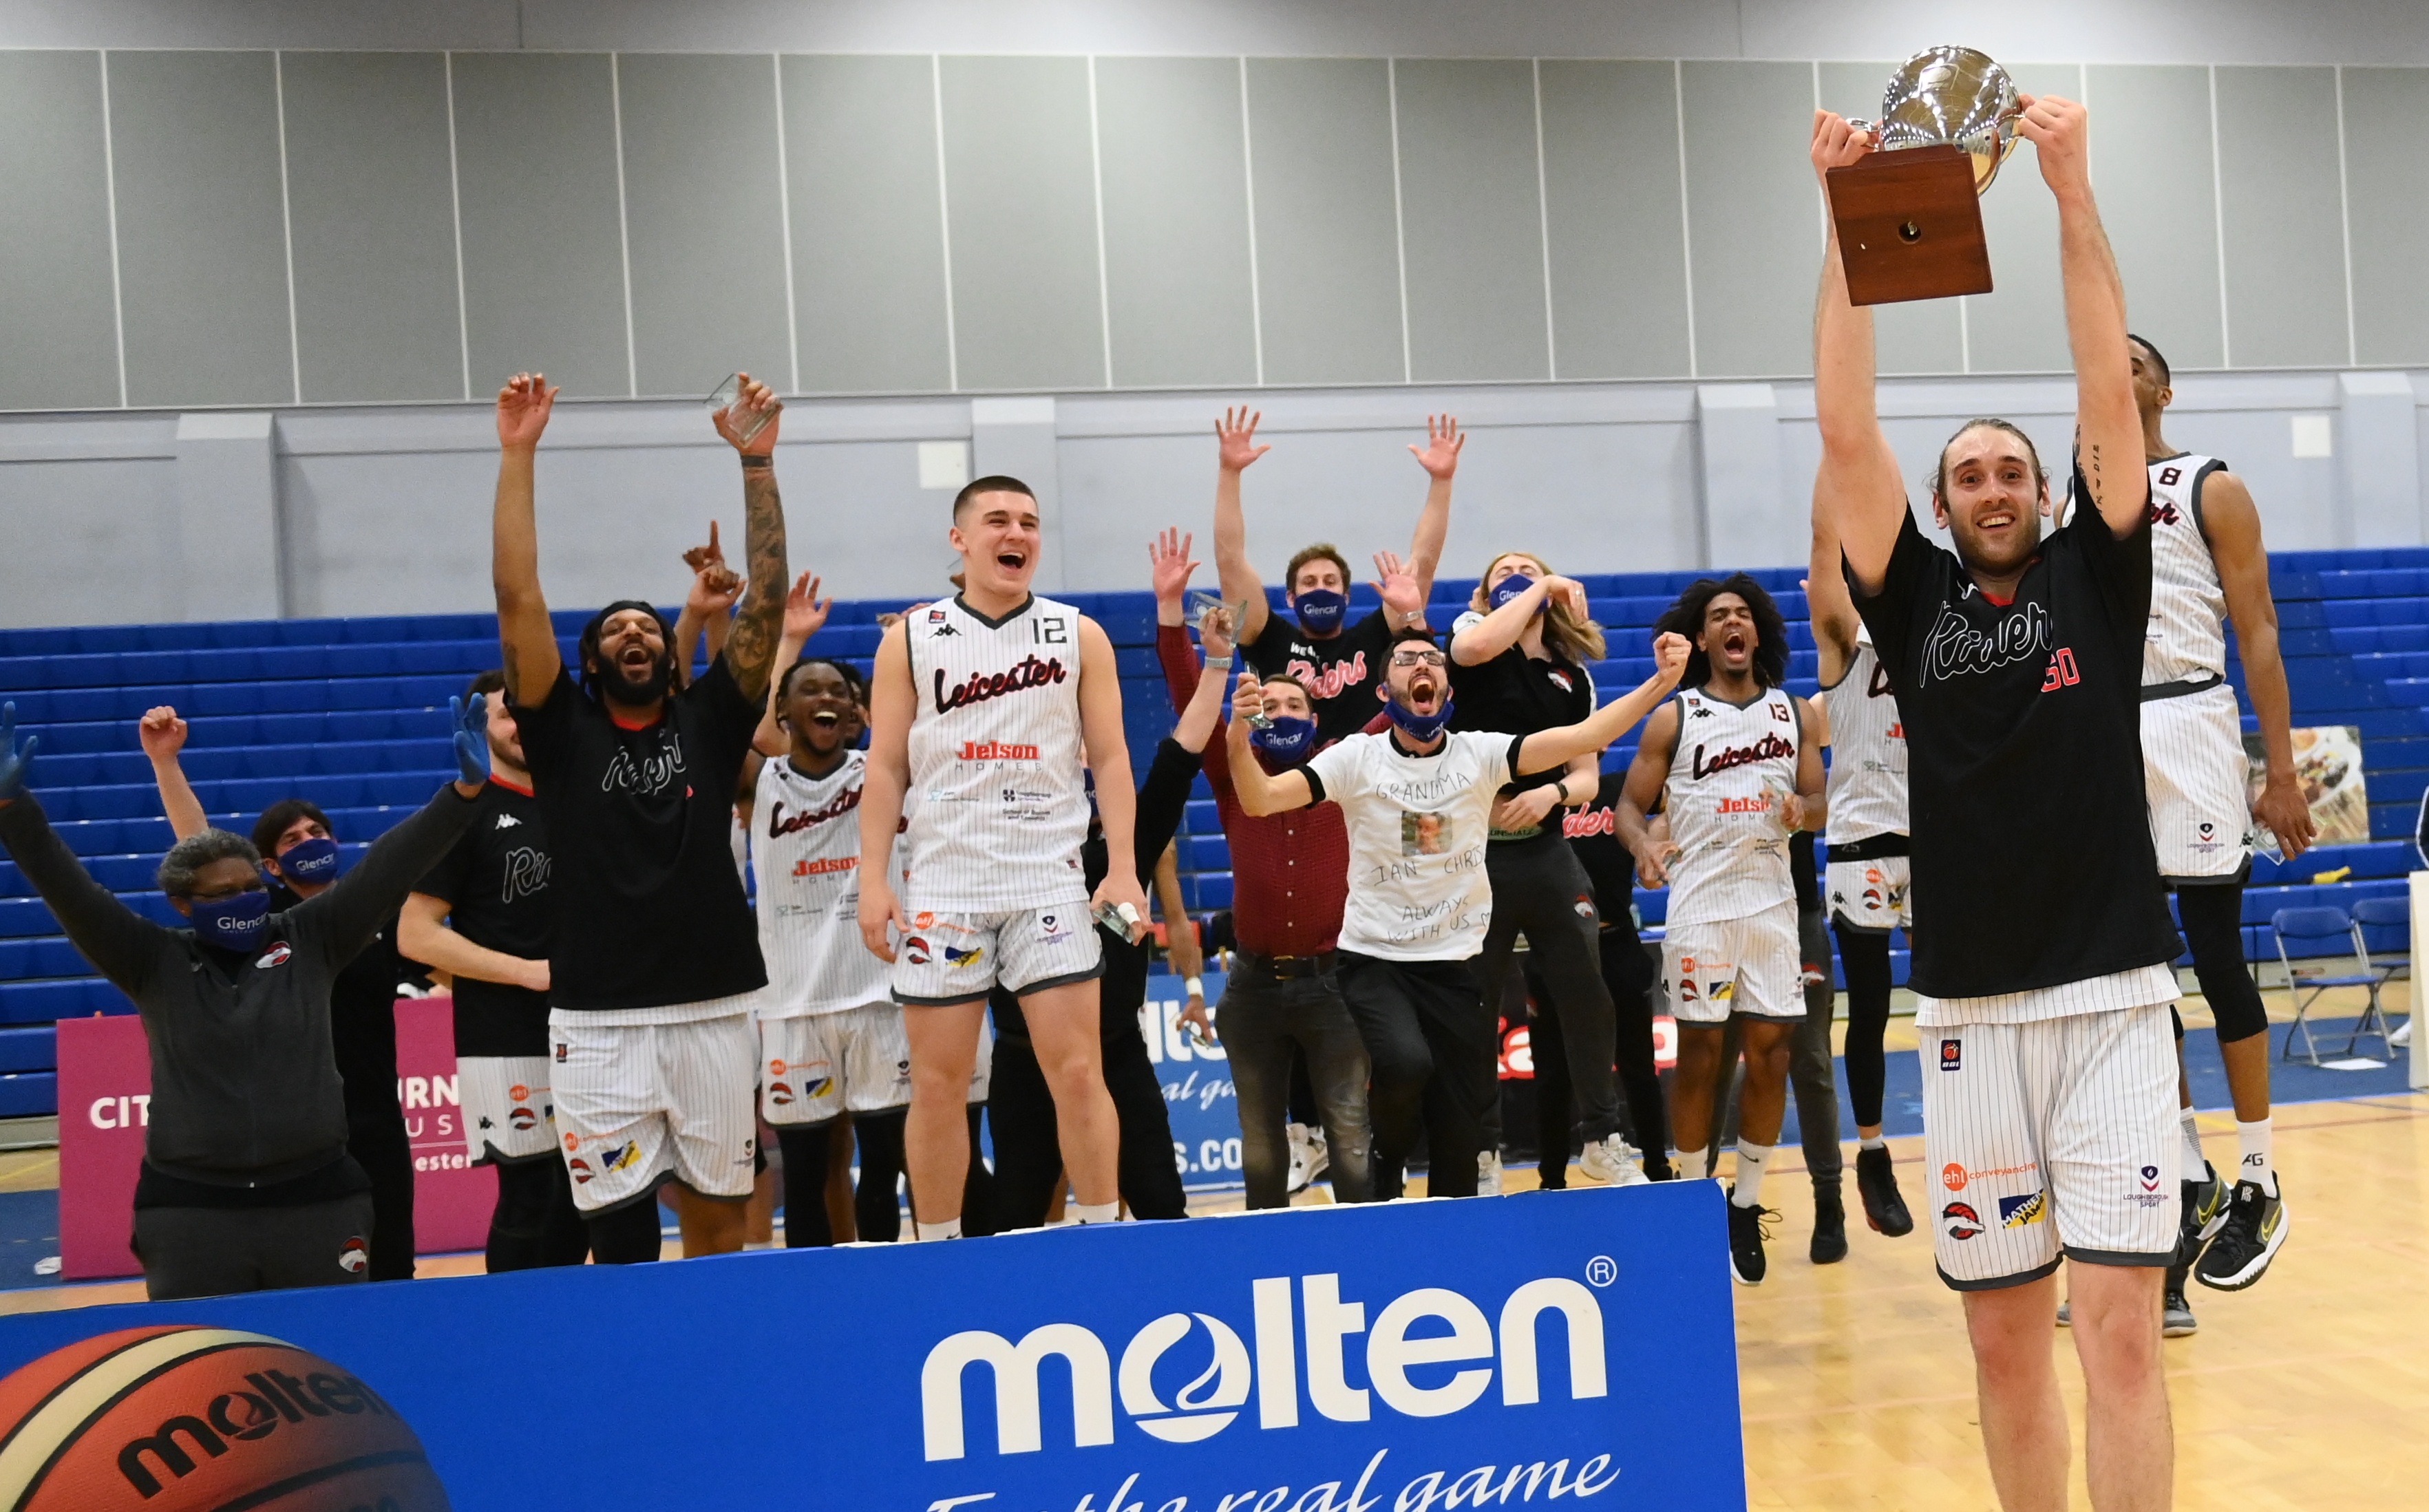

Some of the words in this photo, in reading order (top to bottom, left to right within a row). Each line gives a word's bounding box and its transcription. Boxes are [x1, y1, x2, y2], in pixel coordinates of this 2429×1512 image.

[2158, 467, 2182, 486] 8
[1304, 604, 1338, 615] Glencar
[1033, 617, 1068, 644] 12
[935, 654, 1067, 715] Leicester
[1769, 703, 1790, 723] 13
[958, 741, 1040, 760] Jelson
[1266, 732, 1303, 746] Glencar
[1693, 732, 1795, 780] Leicester
[1377, 772, 1471, 802] GRANDMA
[296, 853, 335, 871] Glencar
[1371, 861, 1417, 886] IAN
[1402, 895, 1468, 922] ALWAYS
[1388, 924, 1441, 942] WITH
[1450, 914, 1470, 930] US
[1943, 1169, 1966, 1184] ehl
[922, 1273, 1607, 1462] molten
[117, 1368, 399, 1500] molten
[1213, 1448, 1388, 1512] real
[1392, 1454, 1621, 1512] game
